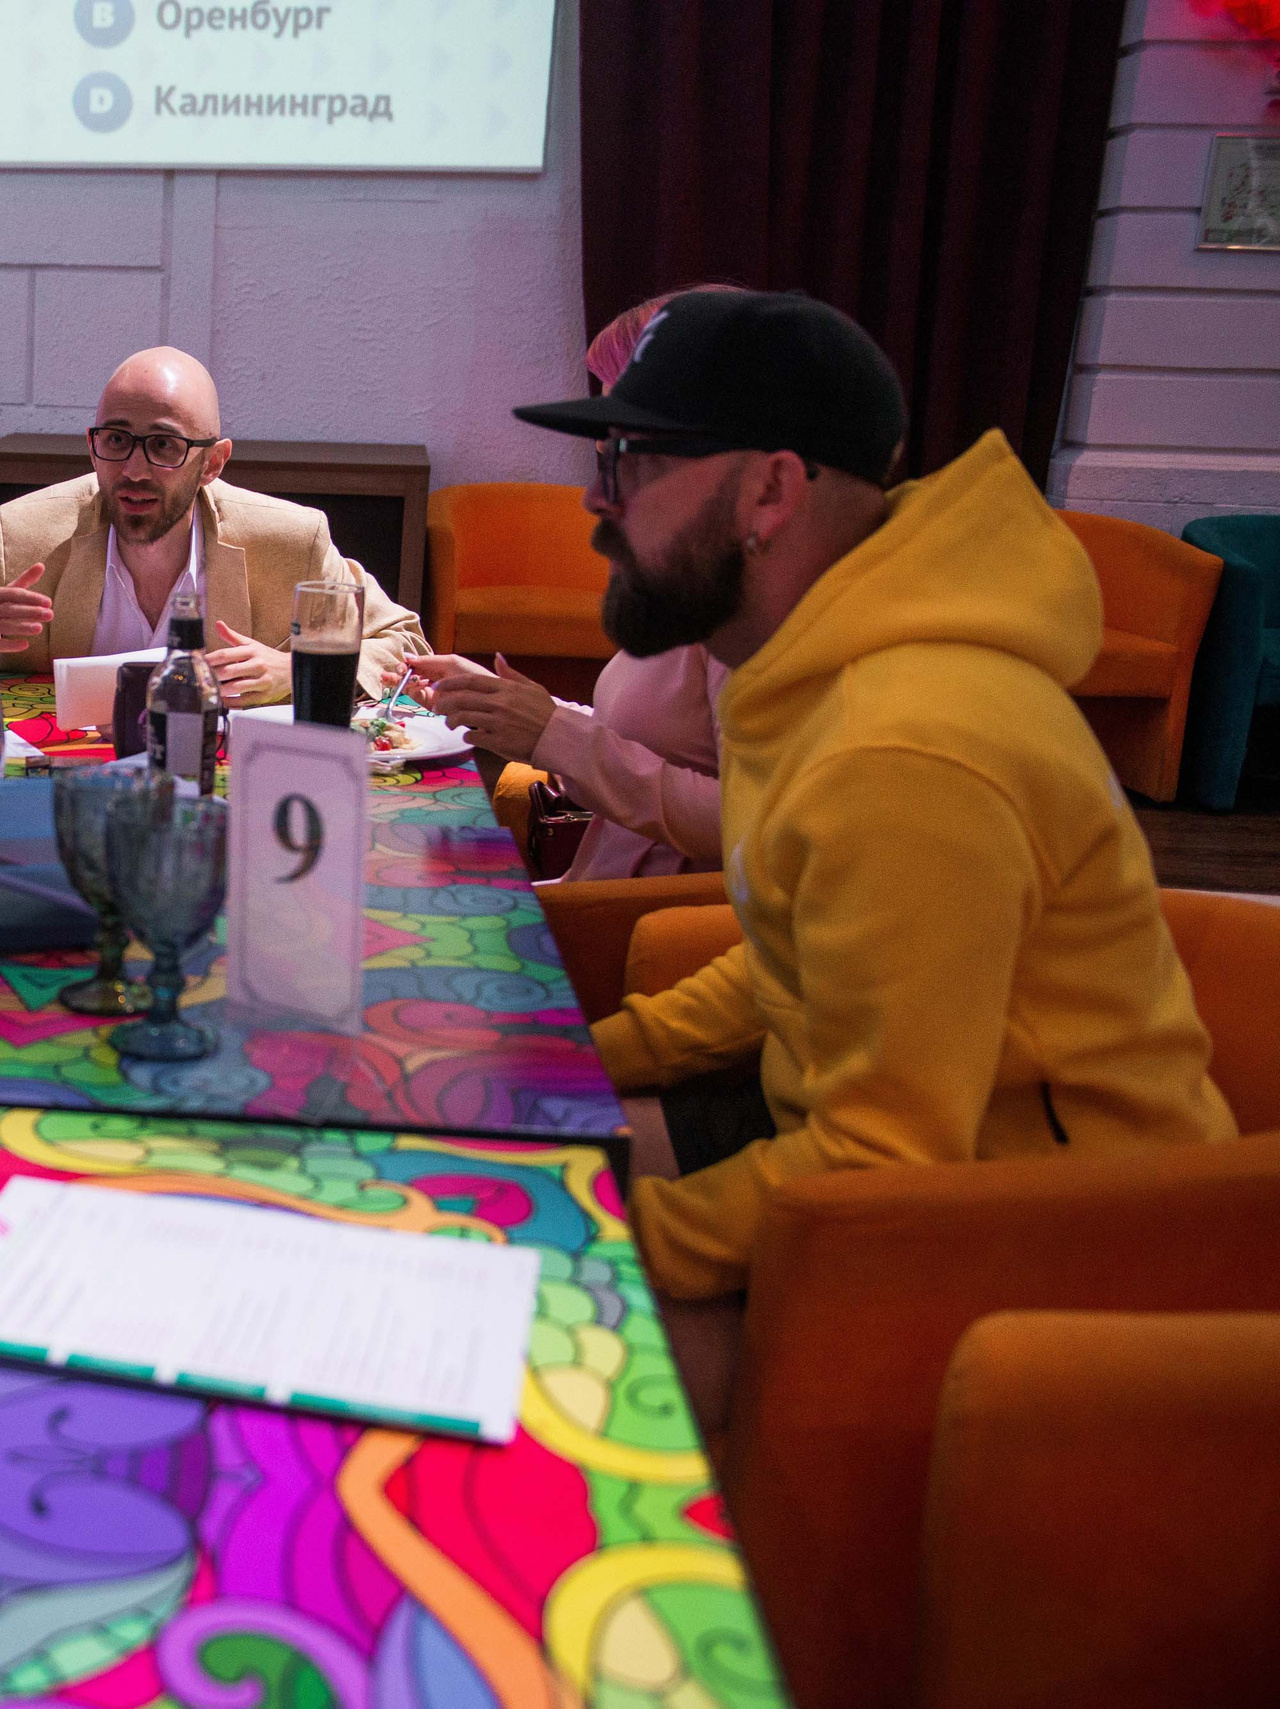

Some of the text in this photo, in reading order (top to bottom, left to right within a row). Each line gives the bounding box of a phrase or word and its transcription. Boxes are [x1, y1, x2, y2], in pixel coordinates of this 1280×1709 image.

[156, 0, 332, 38] Оренбург
[89, 84, 394, 125] D Калининград
[274, 793, 324, 884] 9
